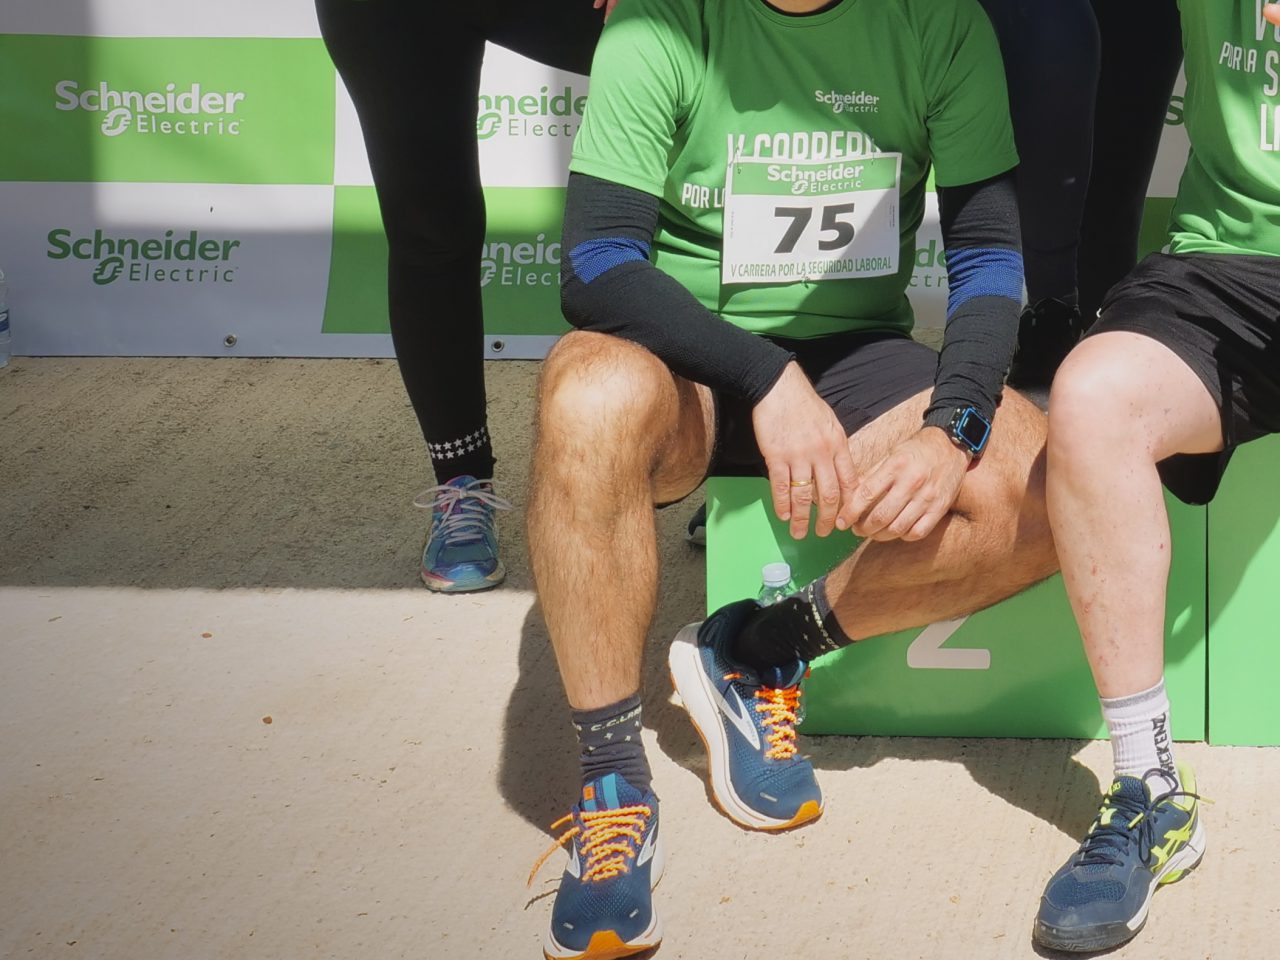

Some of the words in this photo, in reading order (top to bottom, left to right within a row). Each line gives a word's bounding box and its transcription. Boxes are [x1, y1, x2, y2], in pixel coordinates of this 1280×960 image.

[56, 80, 245, 115] Schneider
[815, 90, 879, 105] Schneider
[137, 115, 240, 135] Electric
[767, 164, 864, 182] Schneider
[682, 183, 709, 209] POR
[810, 180, 862, 193] Electric
[773, 203, 855, 254] 75
[47, 229, 240, 262] Schneider
[129, 263, 234, 283] Electric
[738, 263, 776, 277] CARRERA
[778, 263, 794, 276] POR
[808, 258, 854, 274] SEGURIDAD
[855, 256, 892, 272] LABORAL
